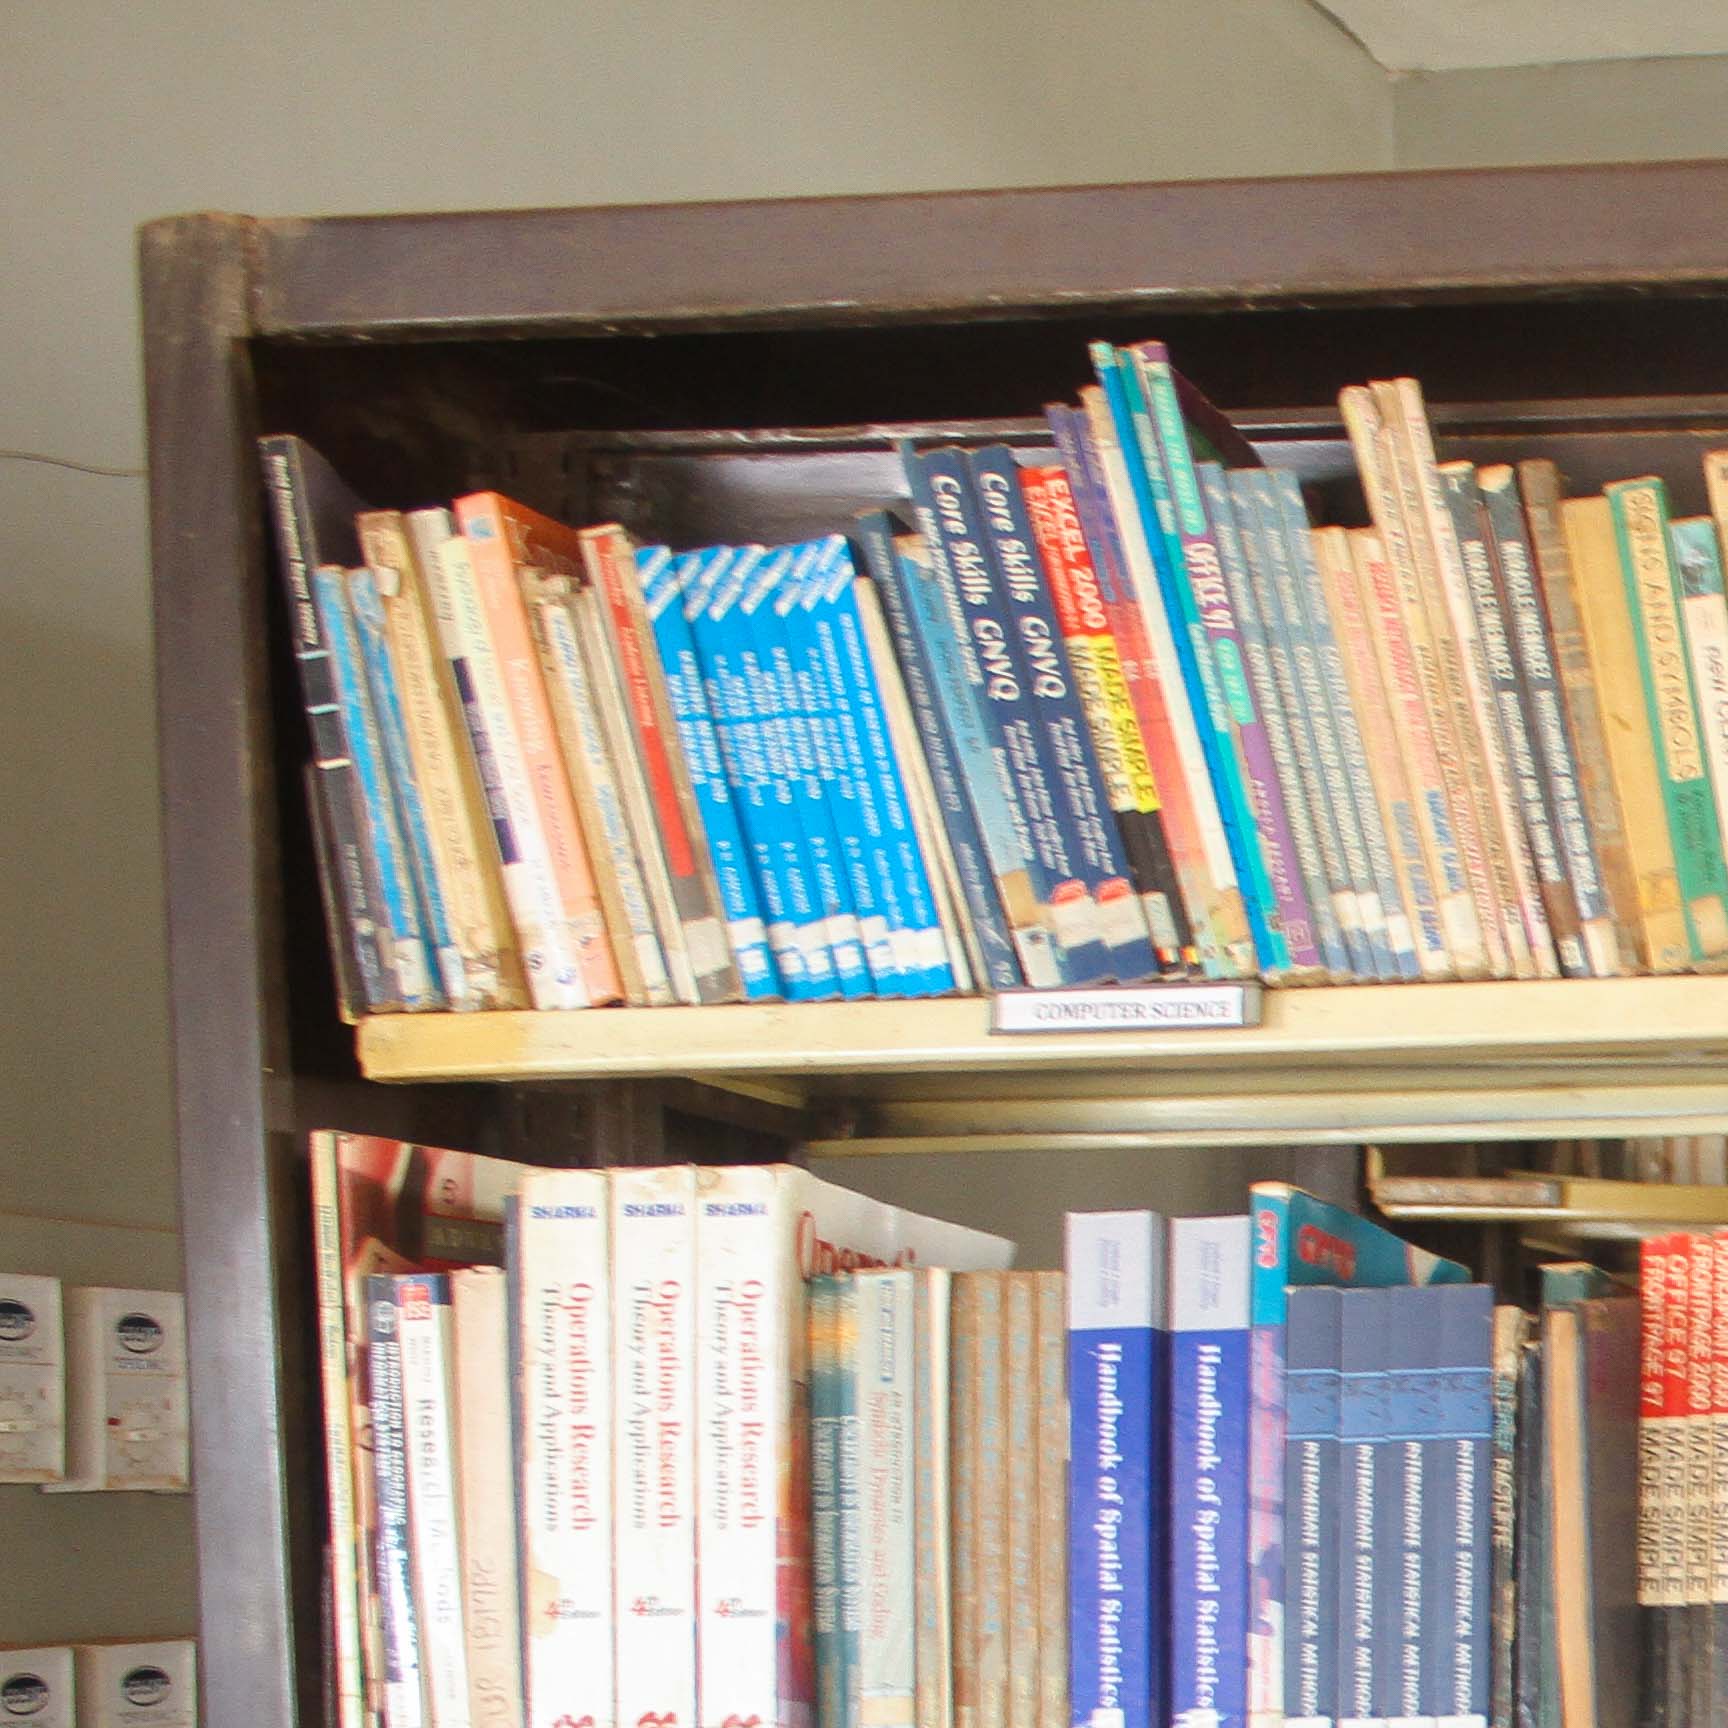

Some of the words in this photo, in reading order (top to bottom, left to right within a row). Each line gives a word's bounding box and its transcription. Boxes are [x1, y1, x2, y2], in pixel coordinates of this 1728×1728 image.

[924, 467, 973, 538] Core
[973, 467, 1023, 536] Core
[946, 536, 995, 610] Skills
[991, 532, 1044, 609] Skills
[1042, 476, 1087, 562] EXCEL
[1067, 563, 1107, 632] 2000
[965, 613, 1024, 708] GNVQ
[1008, 610, 1071, 706] GNVQ
[1034, 1001, 1144, 1021] COMPUTER
[1151, 999, 1231, 1019] SCIENCE
[566, 1283, 596, 1415] Operations
[653, 1279, 683, 1412] Operations
[736, 1279, 766, 1412] Operations
[1642, 1255, 1665, 1377] FRONTPAGE
[1666, 1254, 1689, 1343] OFFICE
[1692, 1241, 1714, 1359] FRONTPAGE
[1094, 1342, 1123, 1469] Handbook
[1196, 1344, 1222, 1470] Handbook
[536, 1405, 562, 1532] Applications
[569, 1424, 596, 1531] Research
[626, 1402, 652, 1529] Applications
[656, 1421, 683, 1528] Research
[708, 1402, 734, 1529] Applications
[739, 1421, 766, 1528] Research
[1299, 1441, 1321, 1545] INTERMEDIATE
[1352, 1444, 1374, 1548] INTERMEDIATE
[1401, 1442, 1423, 1545] INTERMEDIATE
[1453, 1440, 1475, 1544] INTERMEDIATE
[1640, 1428, 1662, 1501] MADE
[1663, 1427, 1685, 1496] MADE
[1687, 1424, 1711, 1497] MADE
[1093, 1509, 1124, 1590] Spatial
[1192, 1510, 1220, 1591] Spatial
[1299, 1551, 1320, 1637] STATISTICAL
[1352, 1555, 1373, 1639] STATISTICAL
[1401, 1552, 1422, 1636] STATISTICAL
[1453, 1550, 1474, 1636] STATISTICAL
[1638, 1505, 1660, 1592] SIMPLE
[1661, 1505, 1684, 1593] SIMPLE
[1098, 1598, 1125, 1708] Statistics
[1194, 1599, 1220, 1707] Statistics
